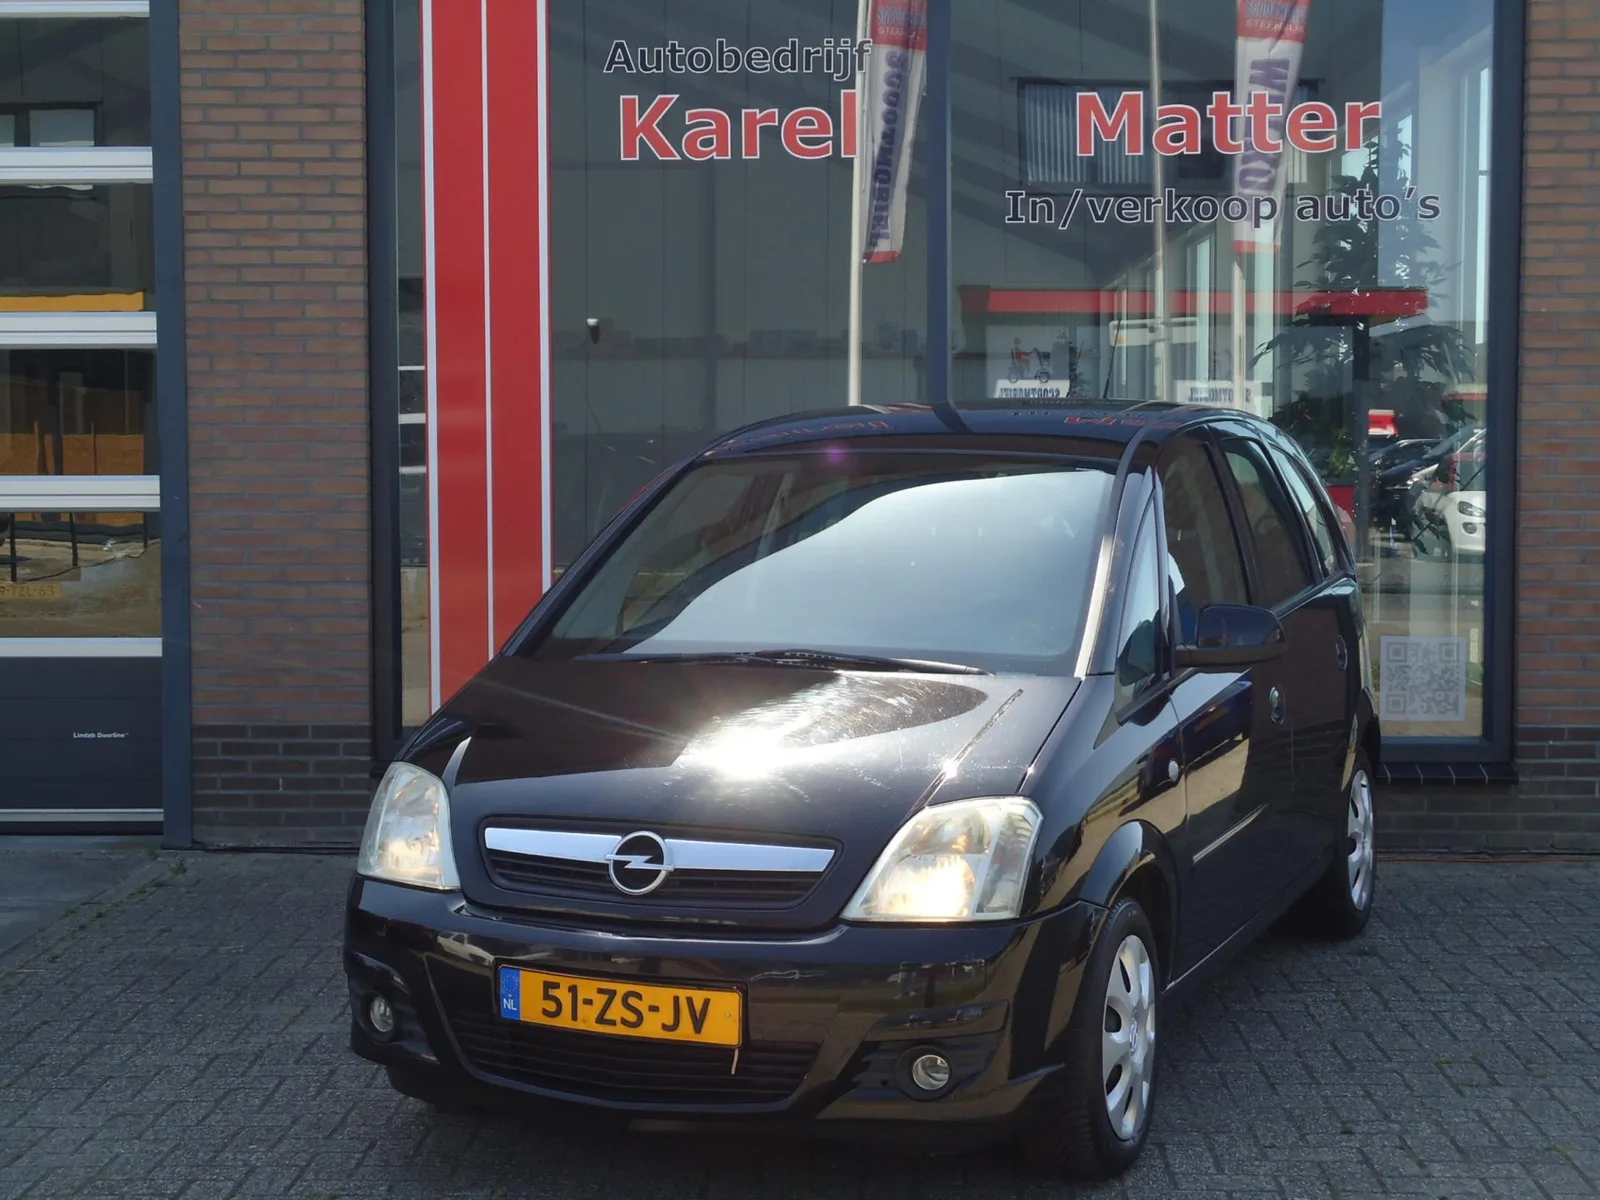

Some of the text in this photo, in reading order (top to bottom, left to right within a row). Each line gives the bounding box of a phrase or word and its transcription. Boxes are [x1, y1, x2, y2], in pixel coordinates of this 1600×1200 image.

[603, 38, 873, 81] Autobedrijf
[619, 89, 861, 161] Karel
[1075, 90, 1382, 157] Matter
[1004, 187, 1441, 230] In/verkoop auto's
[503, 998, 517, 1011] NL
[541, 980, 711, 1035] 51-ZS-JV
